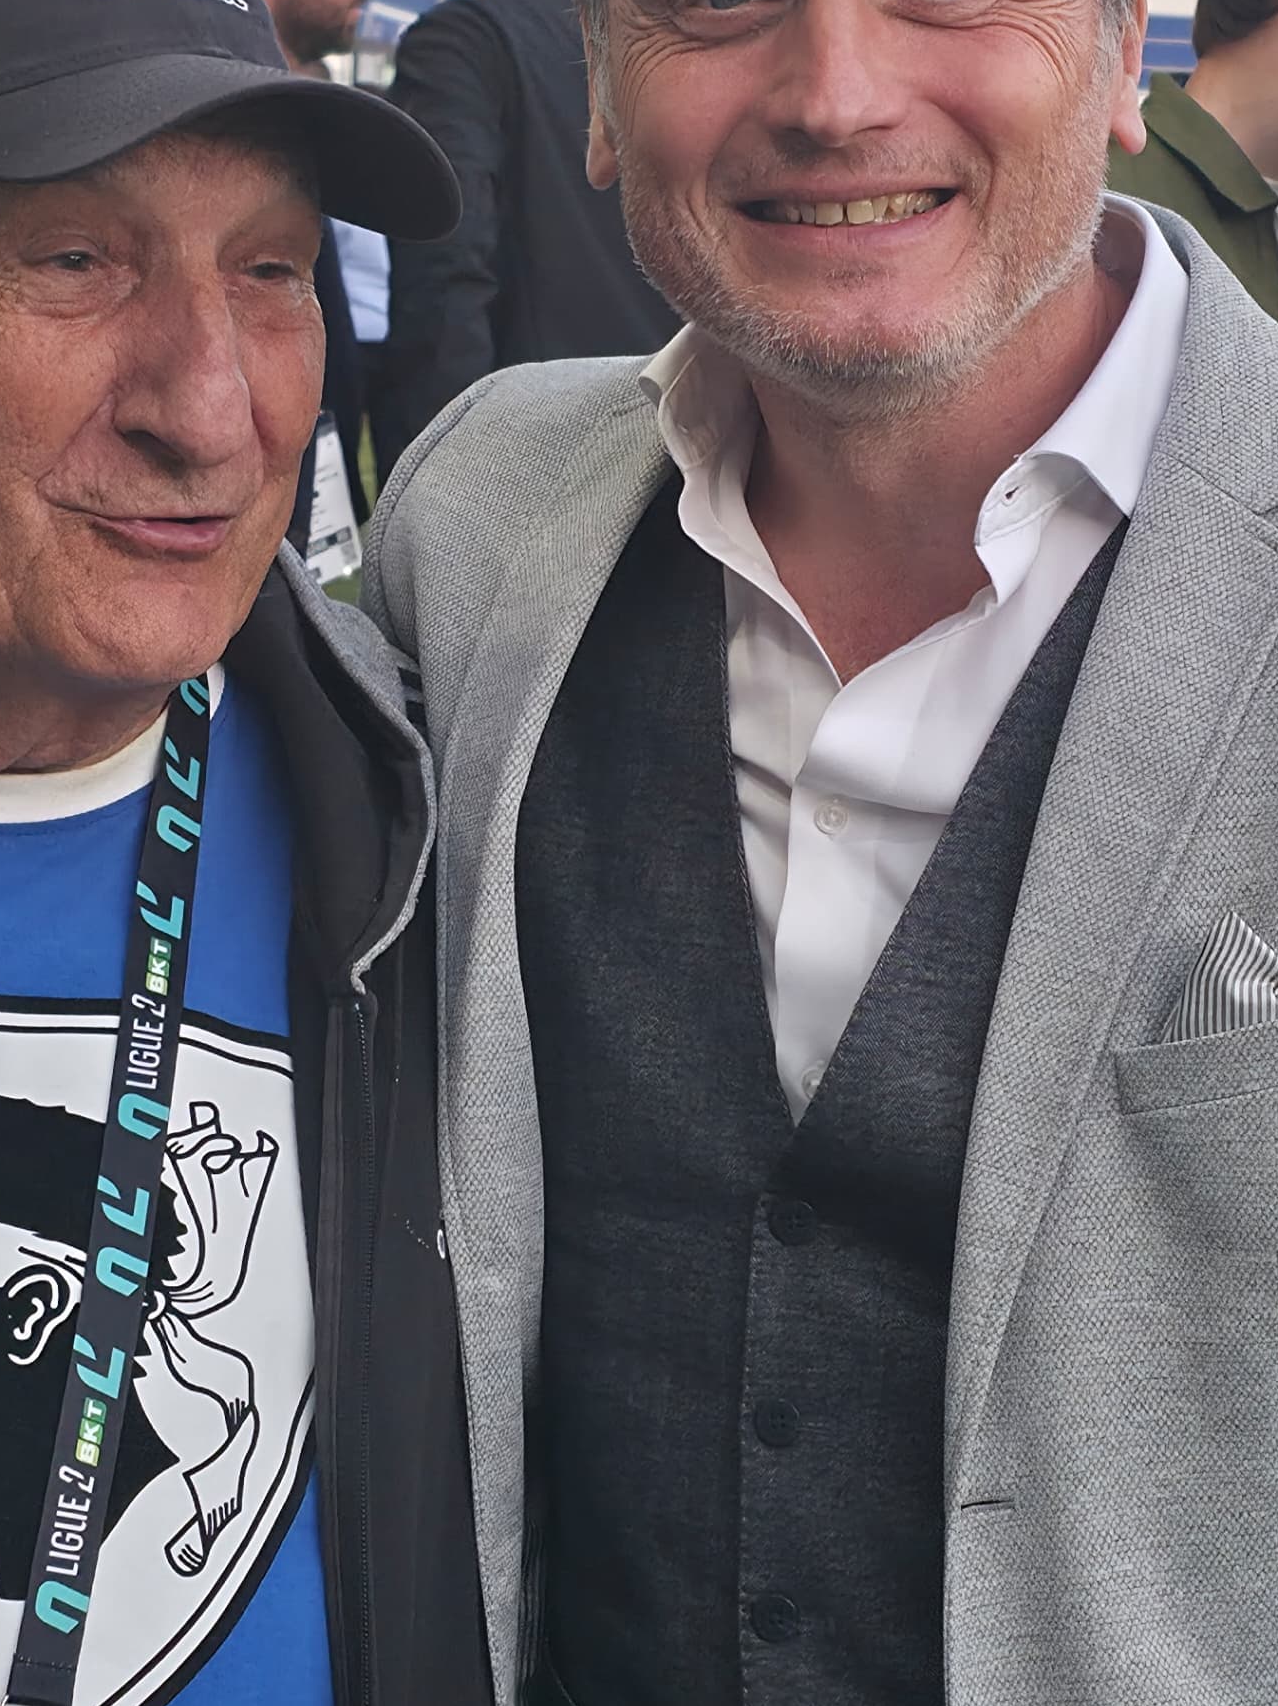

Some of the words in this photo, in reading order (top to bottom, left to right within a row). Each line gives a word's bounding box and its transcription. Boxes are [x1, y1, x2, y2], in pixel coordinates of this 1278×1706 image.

[125, 1017, 164, 1090] LIGUE
[146, 936, 171, 996] BKT
[45, 1493, 91, 1577] LIGUE
[75, 1397, 107, 1467] BKT
